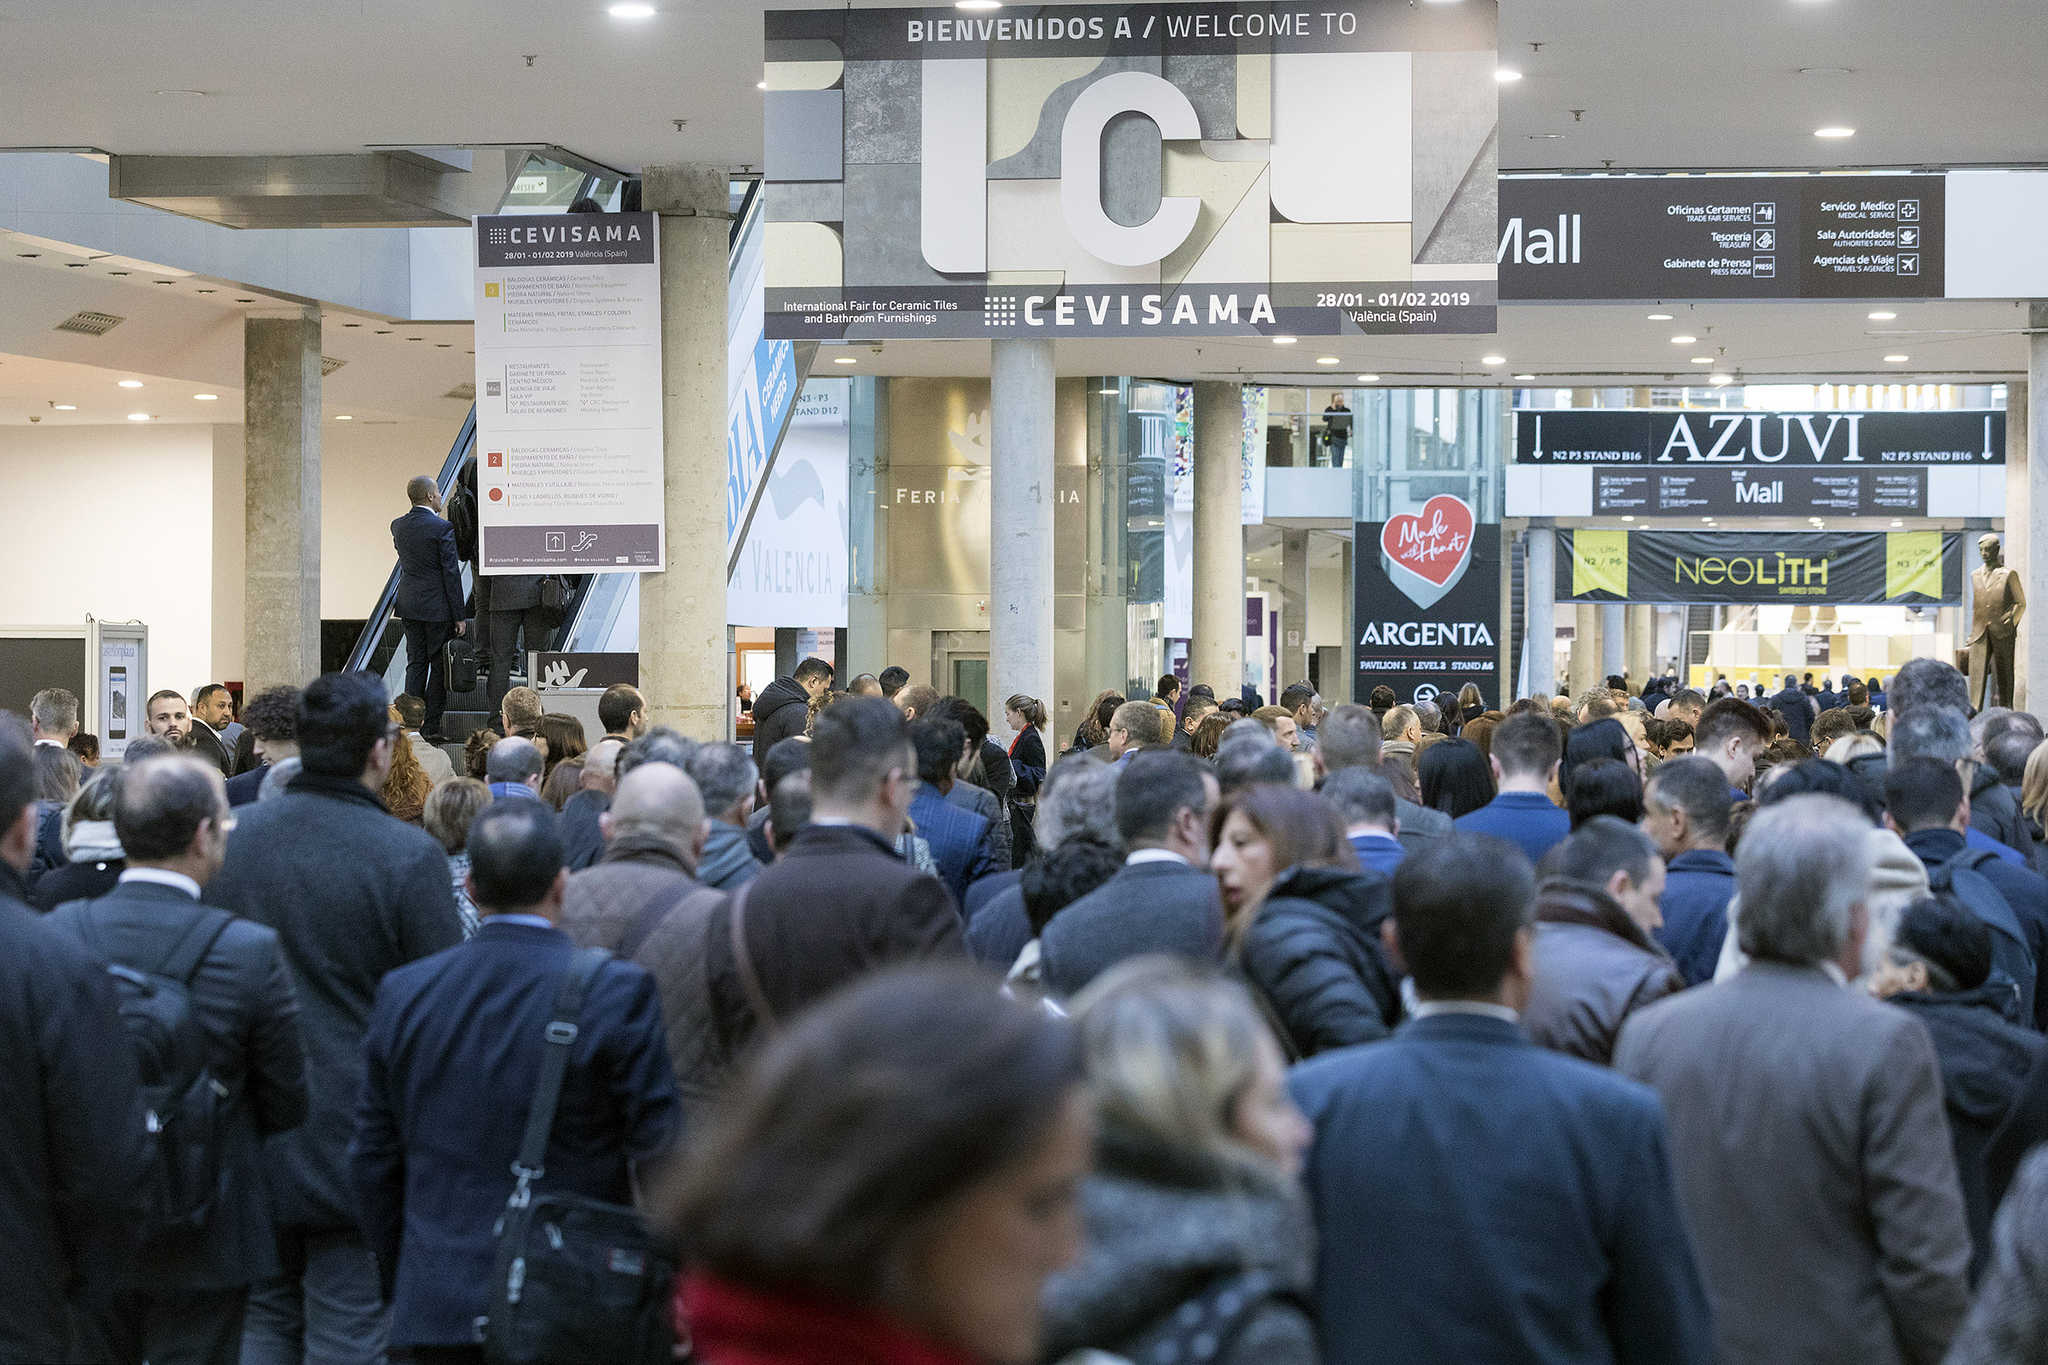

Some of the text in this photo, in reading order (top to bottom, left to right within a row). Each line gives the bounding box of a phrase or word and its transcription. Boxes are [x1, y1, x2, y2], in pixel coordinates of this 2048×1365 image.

[908, 12, 1357, 42] BIENVENIDOS A / WELCOME TO
[1667, 205, 1751, 215] Oficinas Certamen
[1820, 202, 1895, 211] Servicio Medico
[510, 225, 641, 244] CEVISAMA
[1711, 232, 1752, 241] Tesorería
[1817, 229, 1895, 240] Sala Autoridades
[605, 250, 628, 259] (Spain)
[1664, 258, 1751, 268] Gabinete de Prensa
[1813, 255, 1895, 267] Agencias de Viaje
[1711, 268, 1729, 276] PRESS
[784, 300, 958, 311] International Fair for Ceramic Tiles
[1316, 293, 1363, 307] 28/01
[1379, 293, 1426, 306] 01/02
[1431, 293, 1470, 306] 2019
[1024, 293, 1276, 326] CEVISAMA
[804, 314, 937, 324] and Bathroom Furnishings
[1350, 310, 1437, 323] València (Spain)
[794, 407, 820, 416] TAND
[1657, 414, 1864, 463] AZUVI
[1552, 451, 1642, 461] N2 P3 STAND B16
[1881, 452, 1972, 461] N2 P3 STAND B16
[896, 488, 961, 504] FERIA
[1736, 481, 1783, 504] Mall
[1398, 509, 1449, 548] Made
[1400, 532, 1466, 563] with Heart
[1360, 622, 1494, 646] ARGENTA
[1360, 661, 1401, 670] PAVILION
[1413, 661, 1440, 670] LEVEL
[1451, 661, 1481, 671] STAND
